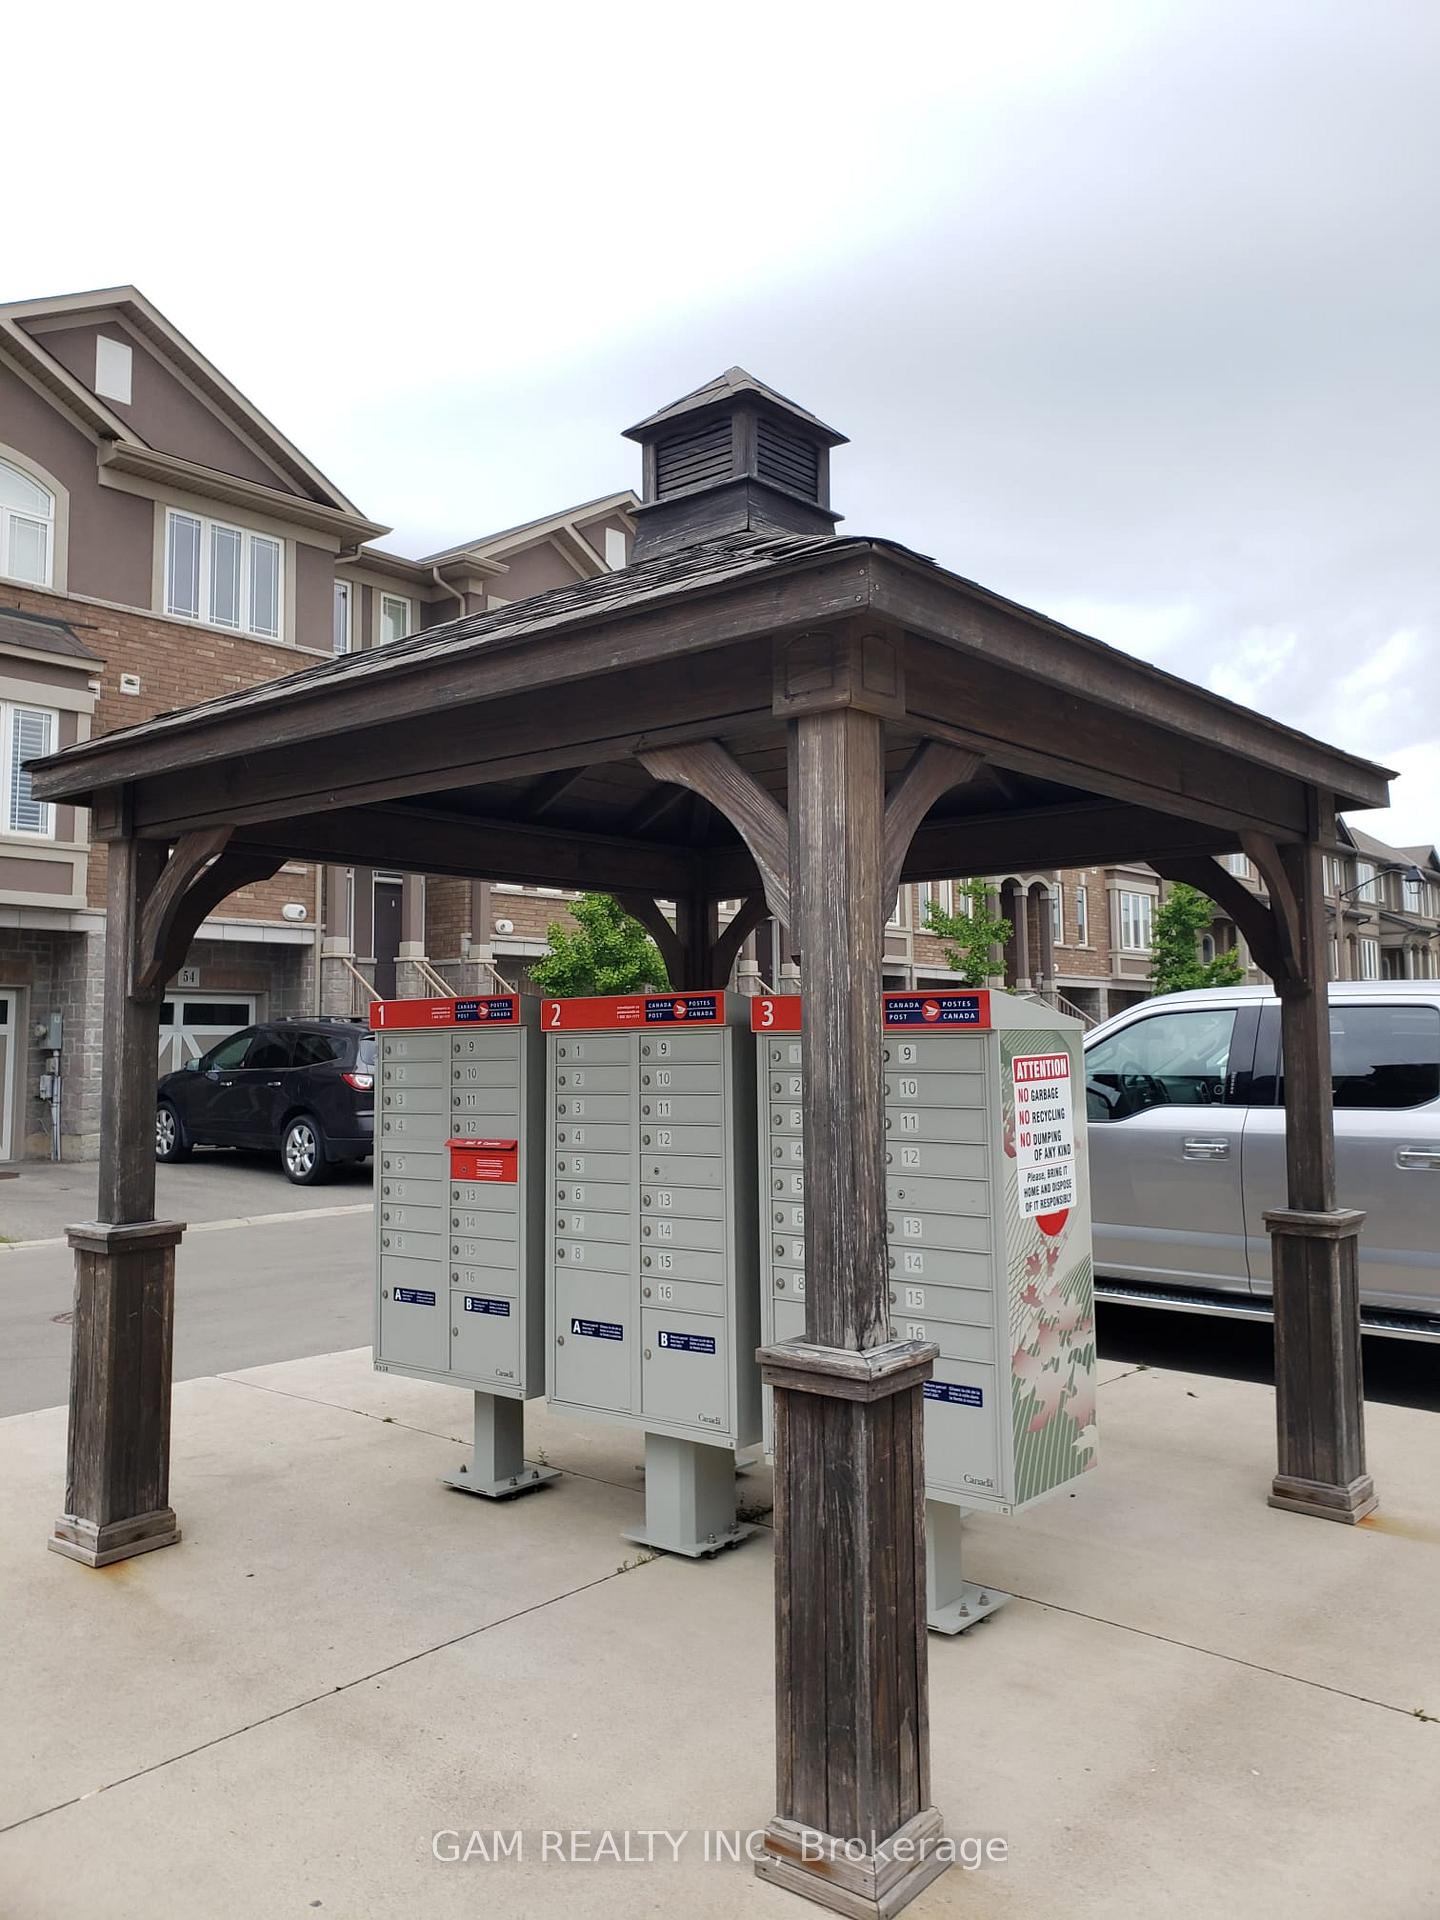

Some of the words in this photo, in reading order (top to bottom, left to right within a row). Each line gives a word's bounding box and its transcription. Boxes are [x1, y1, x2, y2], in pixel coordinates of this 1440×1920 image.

[888, 1001, 920, 1009] CANADA
[942, 1000, 971, 1008] POSTES
[378, 1005, 385, 1026] 1
[551, 1003, 561, 1026] 2
[761, 1000, 774, 1027] 3
[888, 1013, 908, 1021] POST
[942, 1012, 976, 1020] CANADA
[469, 1041, 474, 1051] 9
[576, 1046, 580, 1056] 1
[660, 1043, 667, 1055] 9
[903, 1047, 911, 1060] 9
[467, 1068, 477, 1079] 10
[1016, 1058, 1067, 1080] ATTENTION
[575, 1074, 581, 1085] 2
[659, 1073, 670, 1085] 10
[794, 1079, 800, 1092] 2
[902, 1081, 916, 1094] 10
[467, 1095, 476, 1106] 11
[1018, 1088, 1029, 1103] NO
[1030, 1087, 1059, 1102] GARBAGE
[575, 1102, 581, 1114] 3
[659, 1103, 669, 1114] 11
[795, 1112, 801, 1124] 3
[903, 1116, 916, 1129] 11
[1019, 1110, 1030, 1126] NO
[1032, 1108, 1065, 1124] RECYCLING
[467, 1121, 476, 1132] 12
[575, 1131, 581, 1142] 4
[659, 1132, 670, 1144] 12
[1020, 1132, 1031, 1147] NO
[1033, 1130, 1061, 1146] DUMPING
[795, 1145, 802, 1156] 4
[1034, 1149, 1043, 1161] OF
[1044, 1146, 1056, 1159] ANY
[1057, 1143, 1071, 1157] KIND
[904, 1150, 918, 1164] 12
[575, 1159, 581, 1170] 5
[1027, 1171, 1046, 1182] Please,
[1047, 1167, 1062, 1179] BRING
[1062, 1165, 1068, 1176] IT
[796, 1177, 803, 1190] 5
[1024, 1186, 1040, 1198] HOME
[1040, 1182, 1051, 1195] AND
[1051, 1178, 1072, 1192] DISPOSE
[466, 1190, 476, 1201] 13
[575, 1189, 581, 1200] 6
[660, 1194, 671, 1206] 13
[1025, 1201, 1033, 1213] OF
[1033, 1200, 1039, 1211] IT
[1040, 1193, 1072, 1209] RESPONSIBLY
[797, 1210, 803, 1223] 6
[575, 1218, 581, 1229] 7
[905, 1220, 920, 1234] 13
[660, 1224, 671, 1236] 14
[575, 1248, 581, 1259] 8
[797, 1243, 804, 1256] 7
[660, 1256, 671, 1268] 15
[907, 1257, 922, 1270] 14
[799, 1276, 805, 1290] 8
[395, 1288, 402, 1301] A
[660, 1287, 671, 1298] 16
[907, 1290, 923, 1305] 15
[466, 1298, 472, 1310] B
[573, 1320, 581, 1334] A
[908, 1326, 924, 1340] 16
[660, 1332, 668, 1347] B
[963, 1474, 994, 1488] Canada
